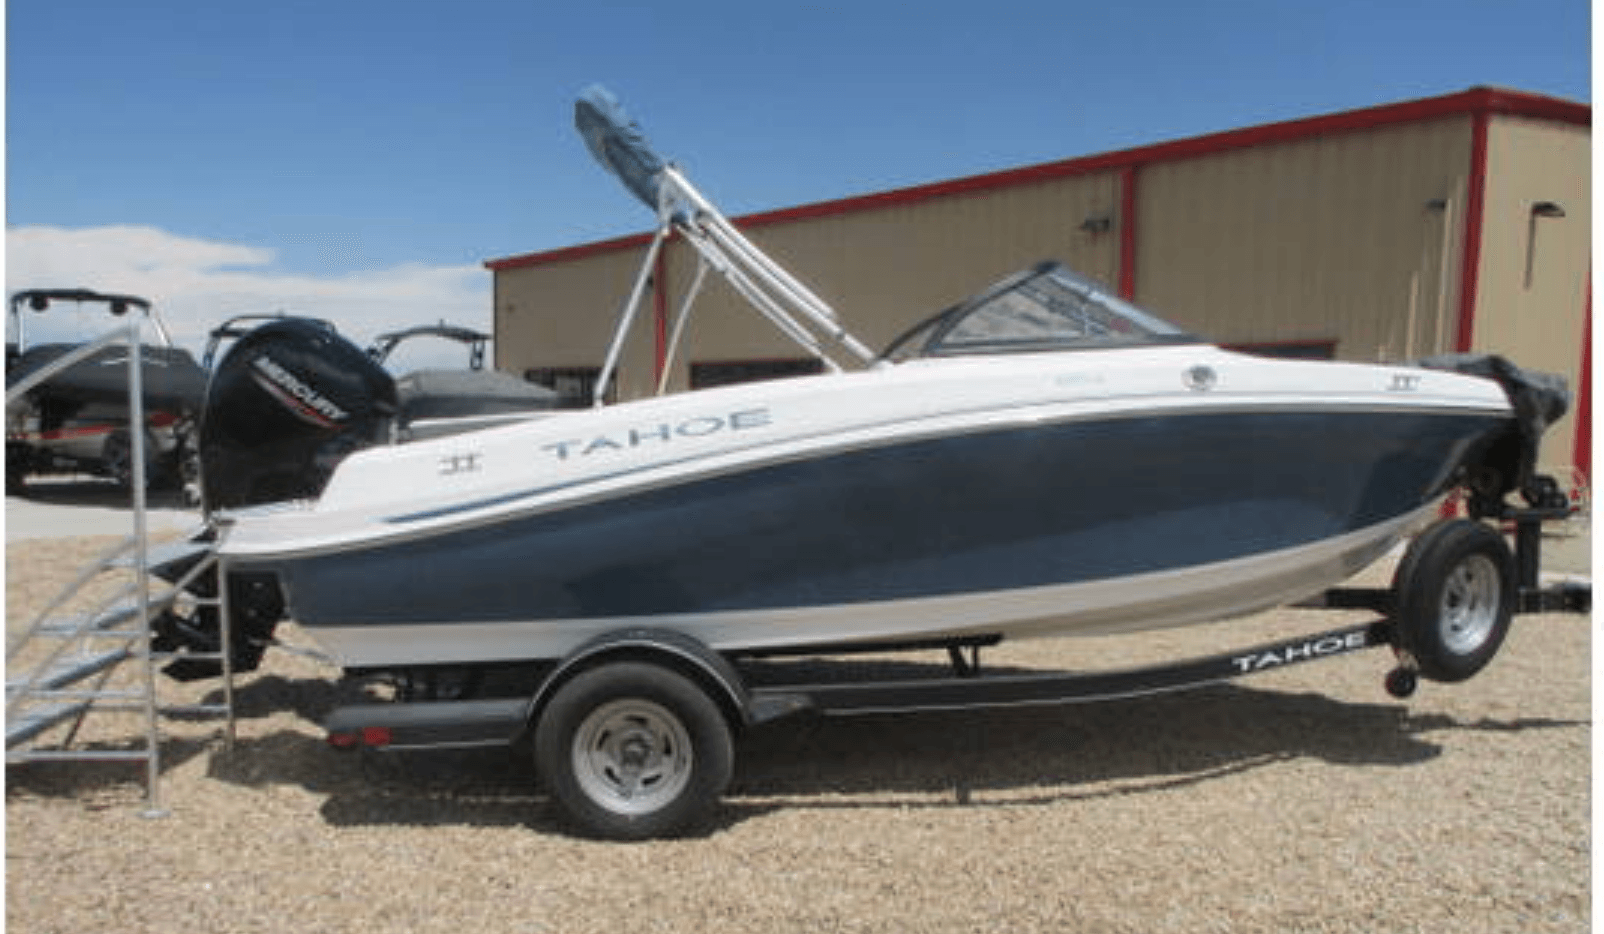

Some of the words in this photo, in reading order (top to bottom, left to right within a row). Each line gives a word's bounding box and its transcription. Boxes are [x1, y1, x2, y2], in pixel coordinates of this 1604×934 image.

[253, 356, 349, 420] MERCURY
[540, 407, 773, 461] TAHOE
[1231, 630, 1366, 672] TAHOE
